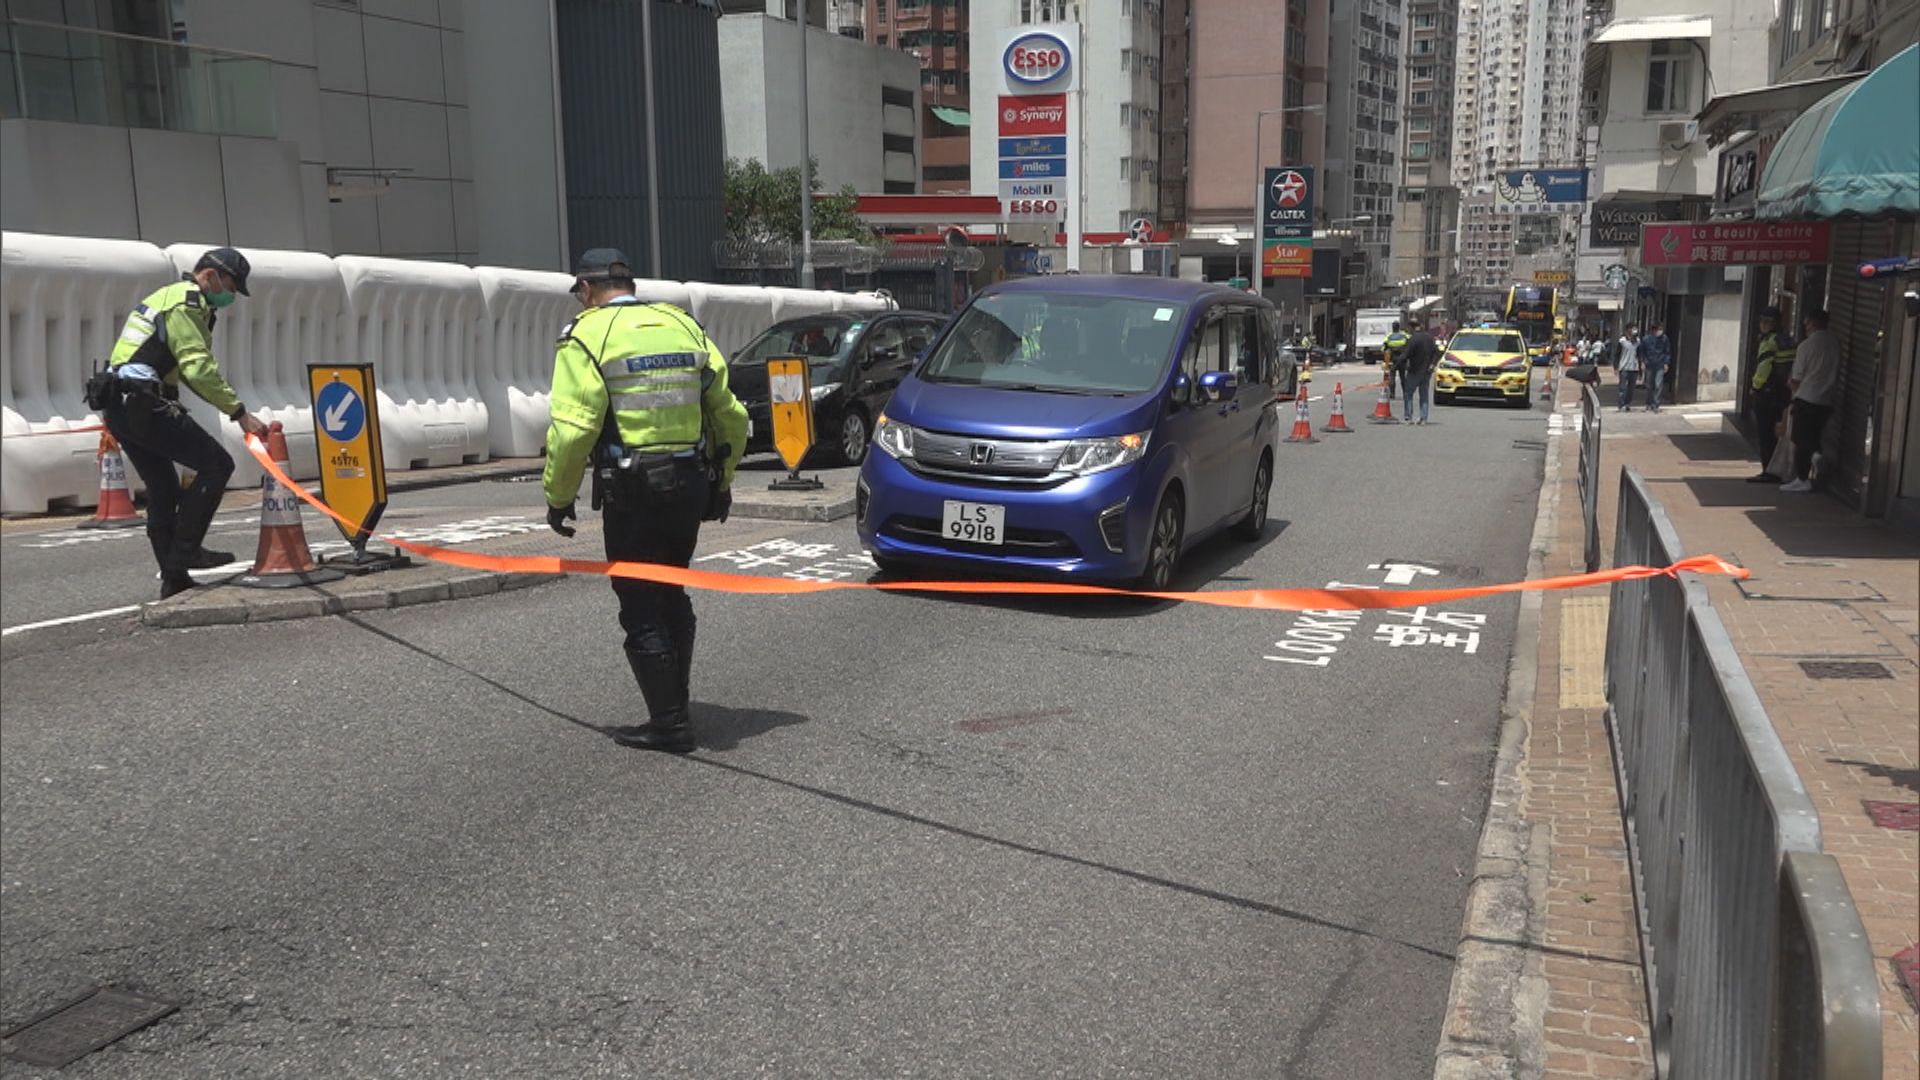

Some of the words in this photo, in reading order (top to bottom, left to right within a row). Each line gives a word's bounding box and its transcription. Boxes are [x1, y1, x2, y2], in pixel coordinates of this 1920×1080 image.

[1019, 109, 1063, 123] Synergy
[1012, 185, 1041, 196] Mobil
[1010, 199, 1058, 214] ESSO
[1270, 209, 1306, 220] CALTEX
[1691, 227, 1707, 240] La
[1714, 226, 1760, 240] Beauty
[1767, 225, 1813, 239] Centre
[1275, 243, 1299, 259] Star
[643, 355, 683, 368] POLICE
[960, 504, 987, 523] LS
[950, 521, 995, 541] 9918
[1262, 615, 1358, 667] LOOK
